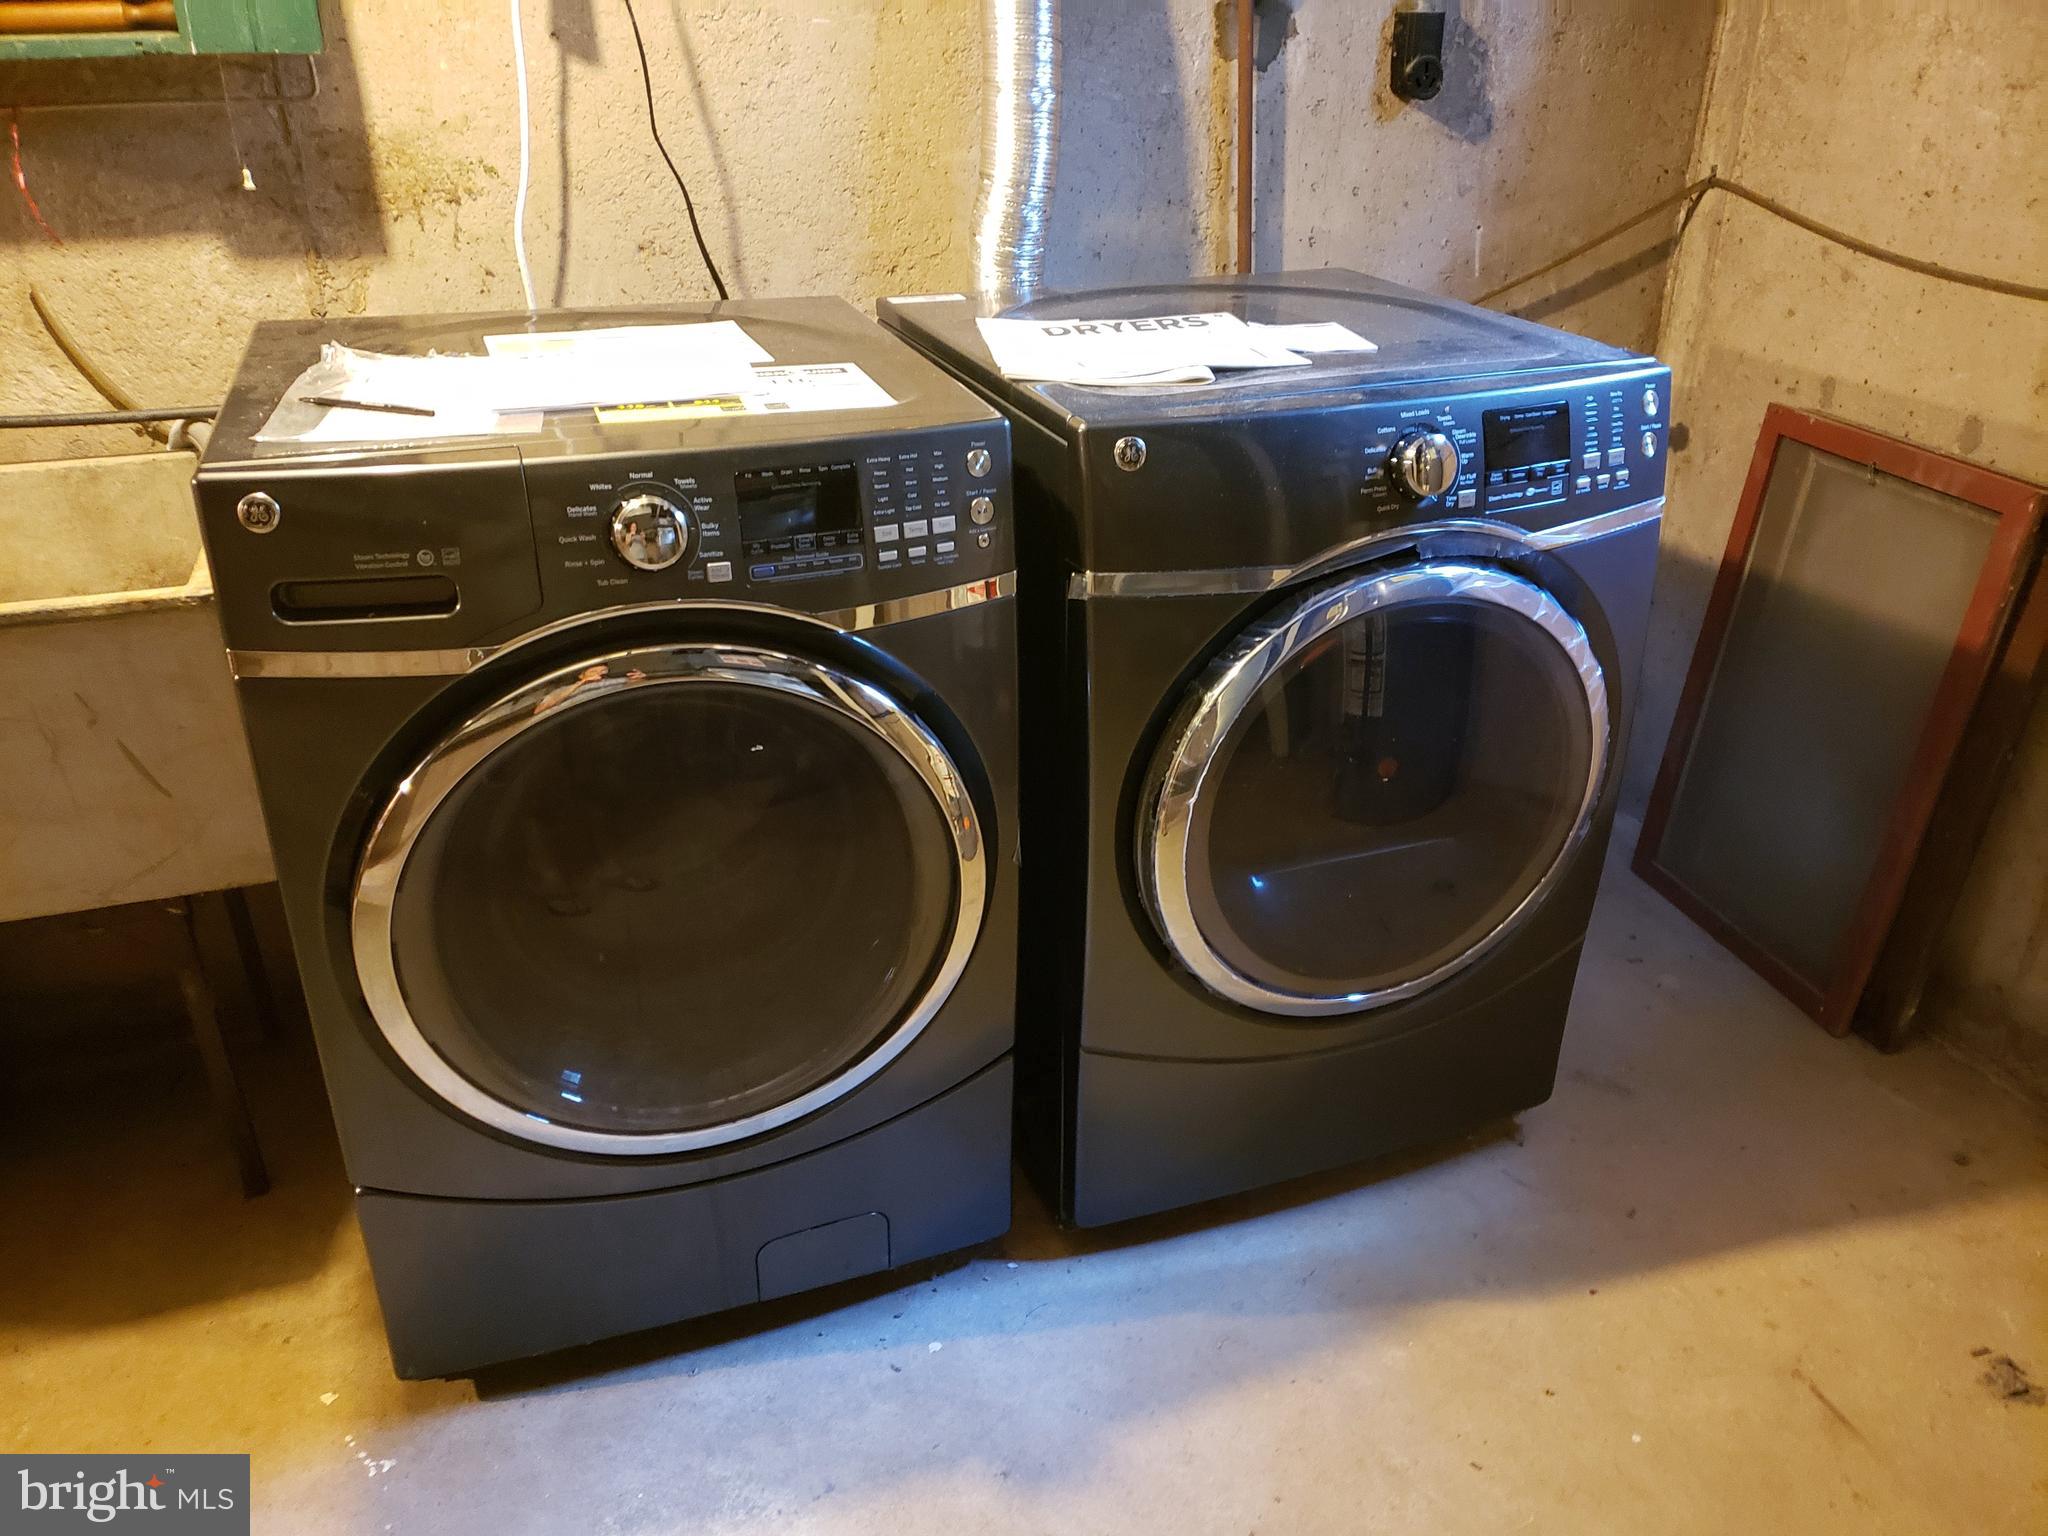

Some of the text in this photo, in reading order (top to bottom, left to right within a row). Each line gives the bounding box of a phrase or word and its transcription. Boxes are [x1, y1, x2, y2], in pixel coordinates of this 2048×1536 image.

[1041, 316, 1209, 337] DRYERS
[1377, 426, 1396, 434] Cottons
[629, 471, 653, 480] Normal
[674, 477, 695, 485] Towels
[589, 483, 612, 491] Whites
[966, 489, 979, 497] Start
[694, 496, 712, 504] Active
[567, 505, 597, 513] Delicates
[1391, 503, 1400, 511] Dry
[702, 522, 719, 531] Bulky
[703, 529, 720, 537] Items
[559, 534, 597, 544] Quick Wash
[565, 560, 583, 568] Rinse
[590, 559, 605, 568] Spin
[596, 578, 629, 587] Tub Clean
